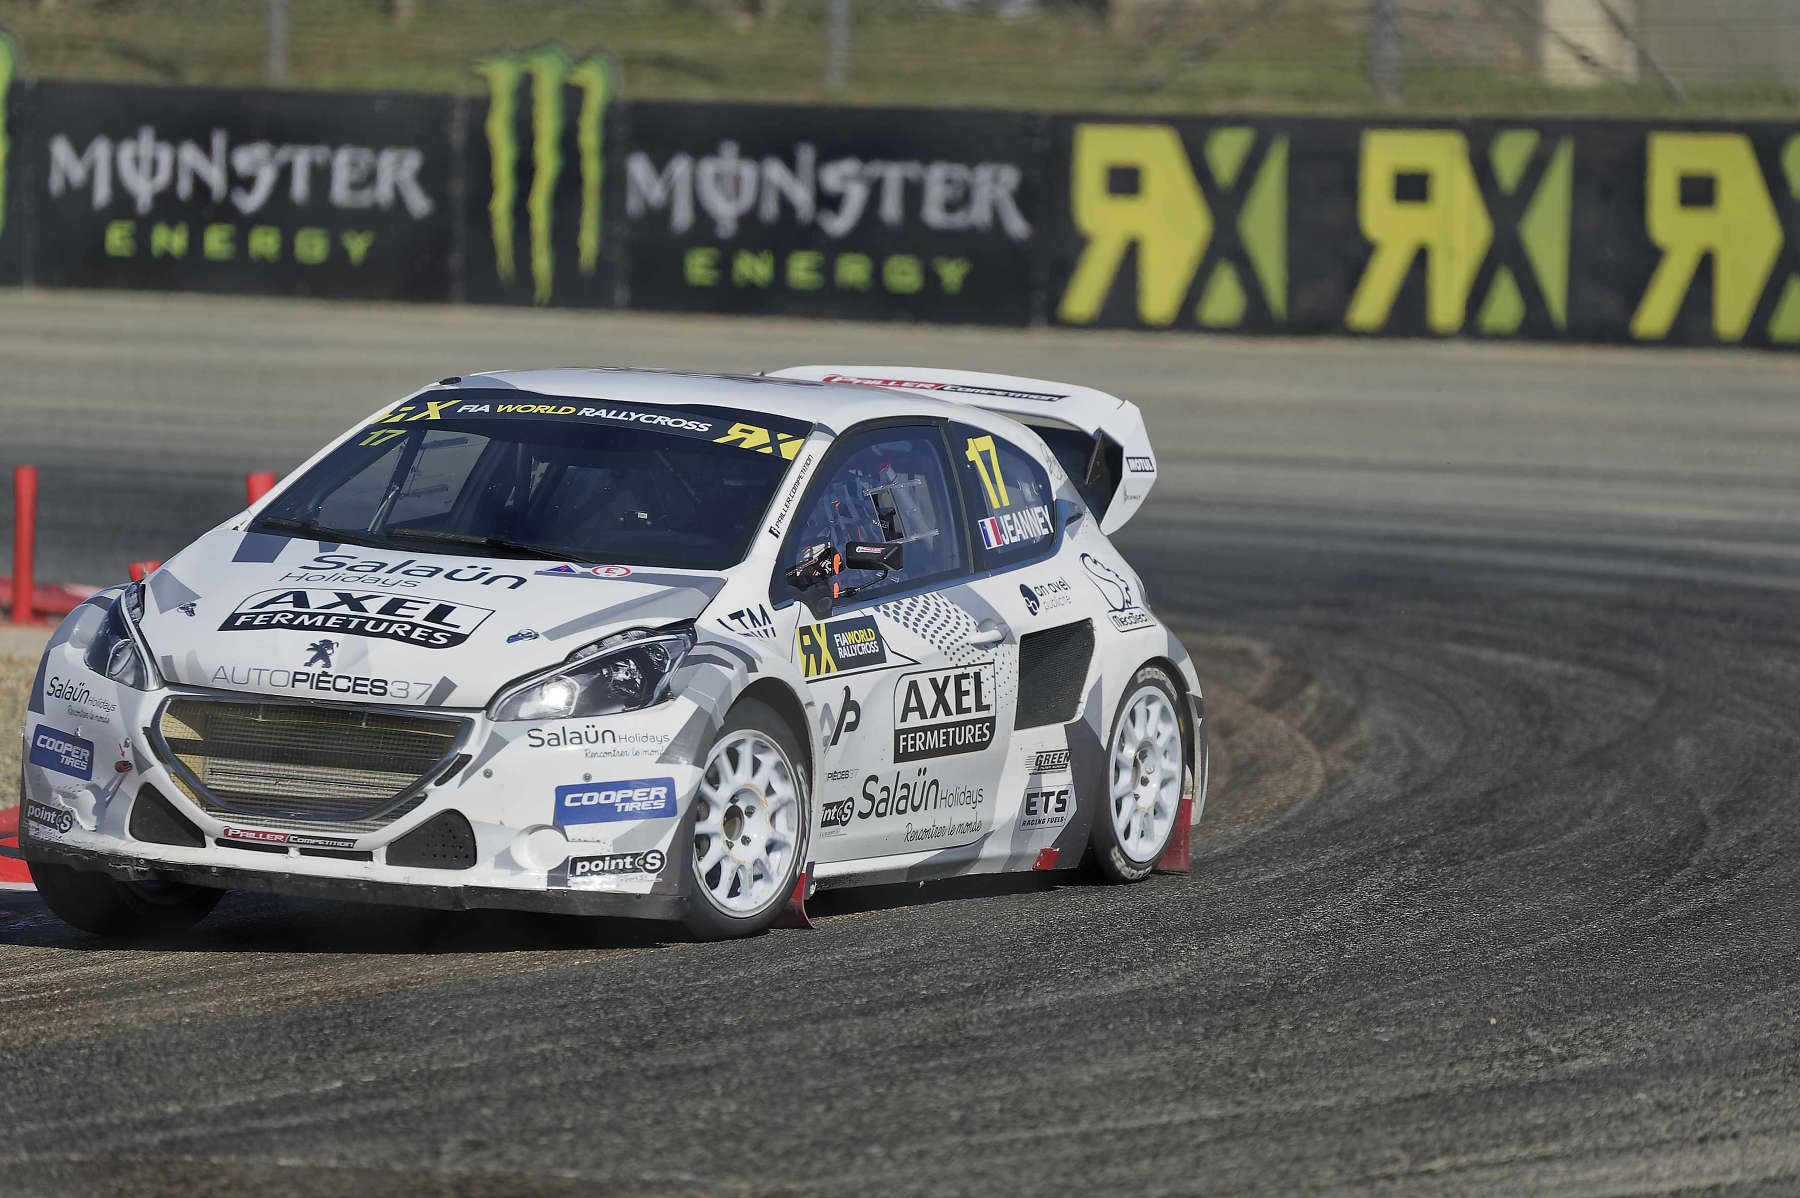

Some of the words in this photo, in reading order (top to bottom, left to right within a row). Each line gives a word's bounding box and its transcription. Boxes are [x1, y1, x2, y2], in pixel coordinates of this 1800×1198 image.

[49, 125, 432, 219] MONSTER
[626, 140, 1032, 240] MONSTER
[104, 219, 375, 265] ENERGY
[684, 246, 971, 294] ENERGY
[457, 404, 490, 413] FIA
[496, 404, 577, 415] WORLD
[577, 407, 713, 432] RALLYCROSS
[359, 429, 407, 446] 17
[965, 435, 1010, 509] 17
[999, 505, 1054, 545] JEANNEY
[279, 572, 420, 588] Holidays
[299, 553, 527, 590] Salaün
[251, 590, 464, 628] AXEL
[234, 611, 452, 646] FERMETURES
[838, 641, 880, 659] RALLYCROSS
[47, 676, 90, 704] Salaün
[900, 671, 991, 723] AXEL
[36, 734, 90, 763] COOPER
[527, 725, 615, 748] Salaün
[618, 732, 670, 745] Holidays
[899, 723, 991, 753] FERMETURES
[60, 754, 88, 771] TIRES
[1035, 751, 1071, 767] GREEN
[564, 786, 667, 807] COOPER
[615, 799, 666, 812] TIRES
[857, 767, 940, 820] Salaün
[939, 784, 983, 810] Holidays
[1025, 790, 1069, 816] ETS
[27, 804, 56, 825] point
[1022, 818, 1046, 826] RACING
[1047, 816, 1064, 824] FUELS
[576, 856, 633, 875] point
